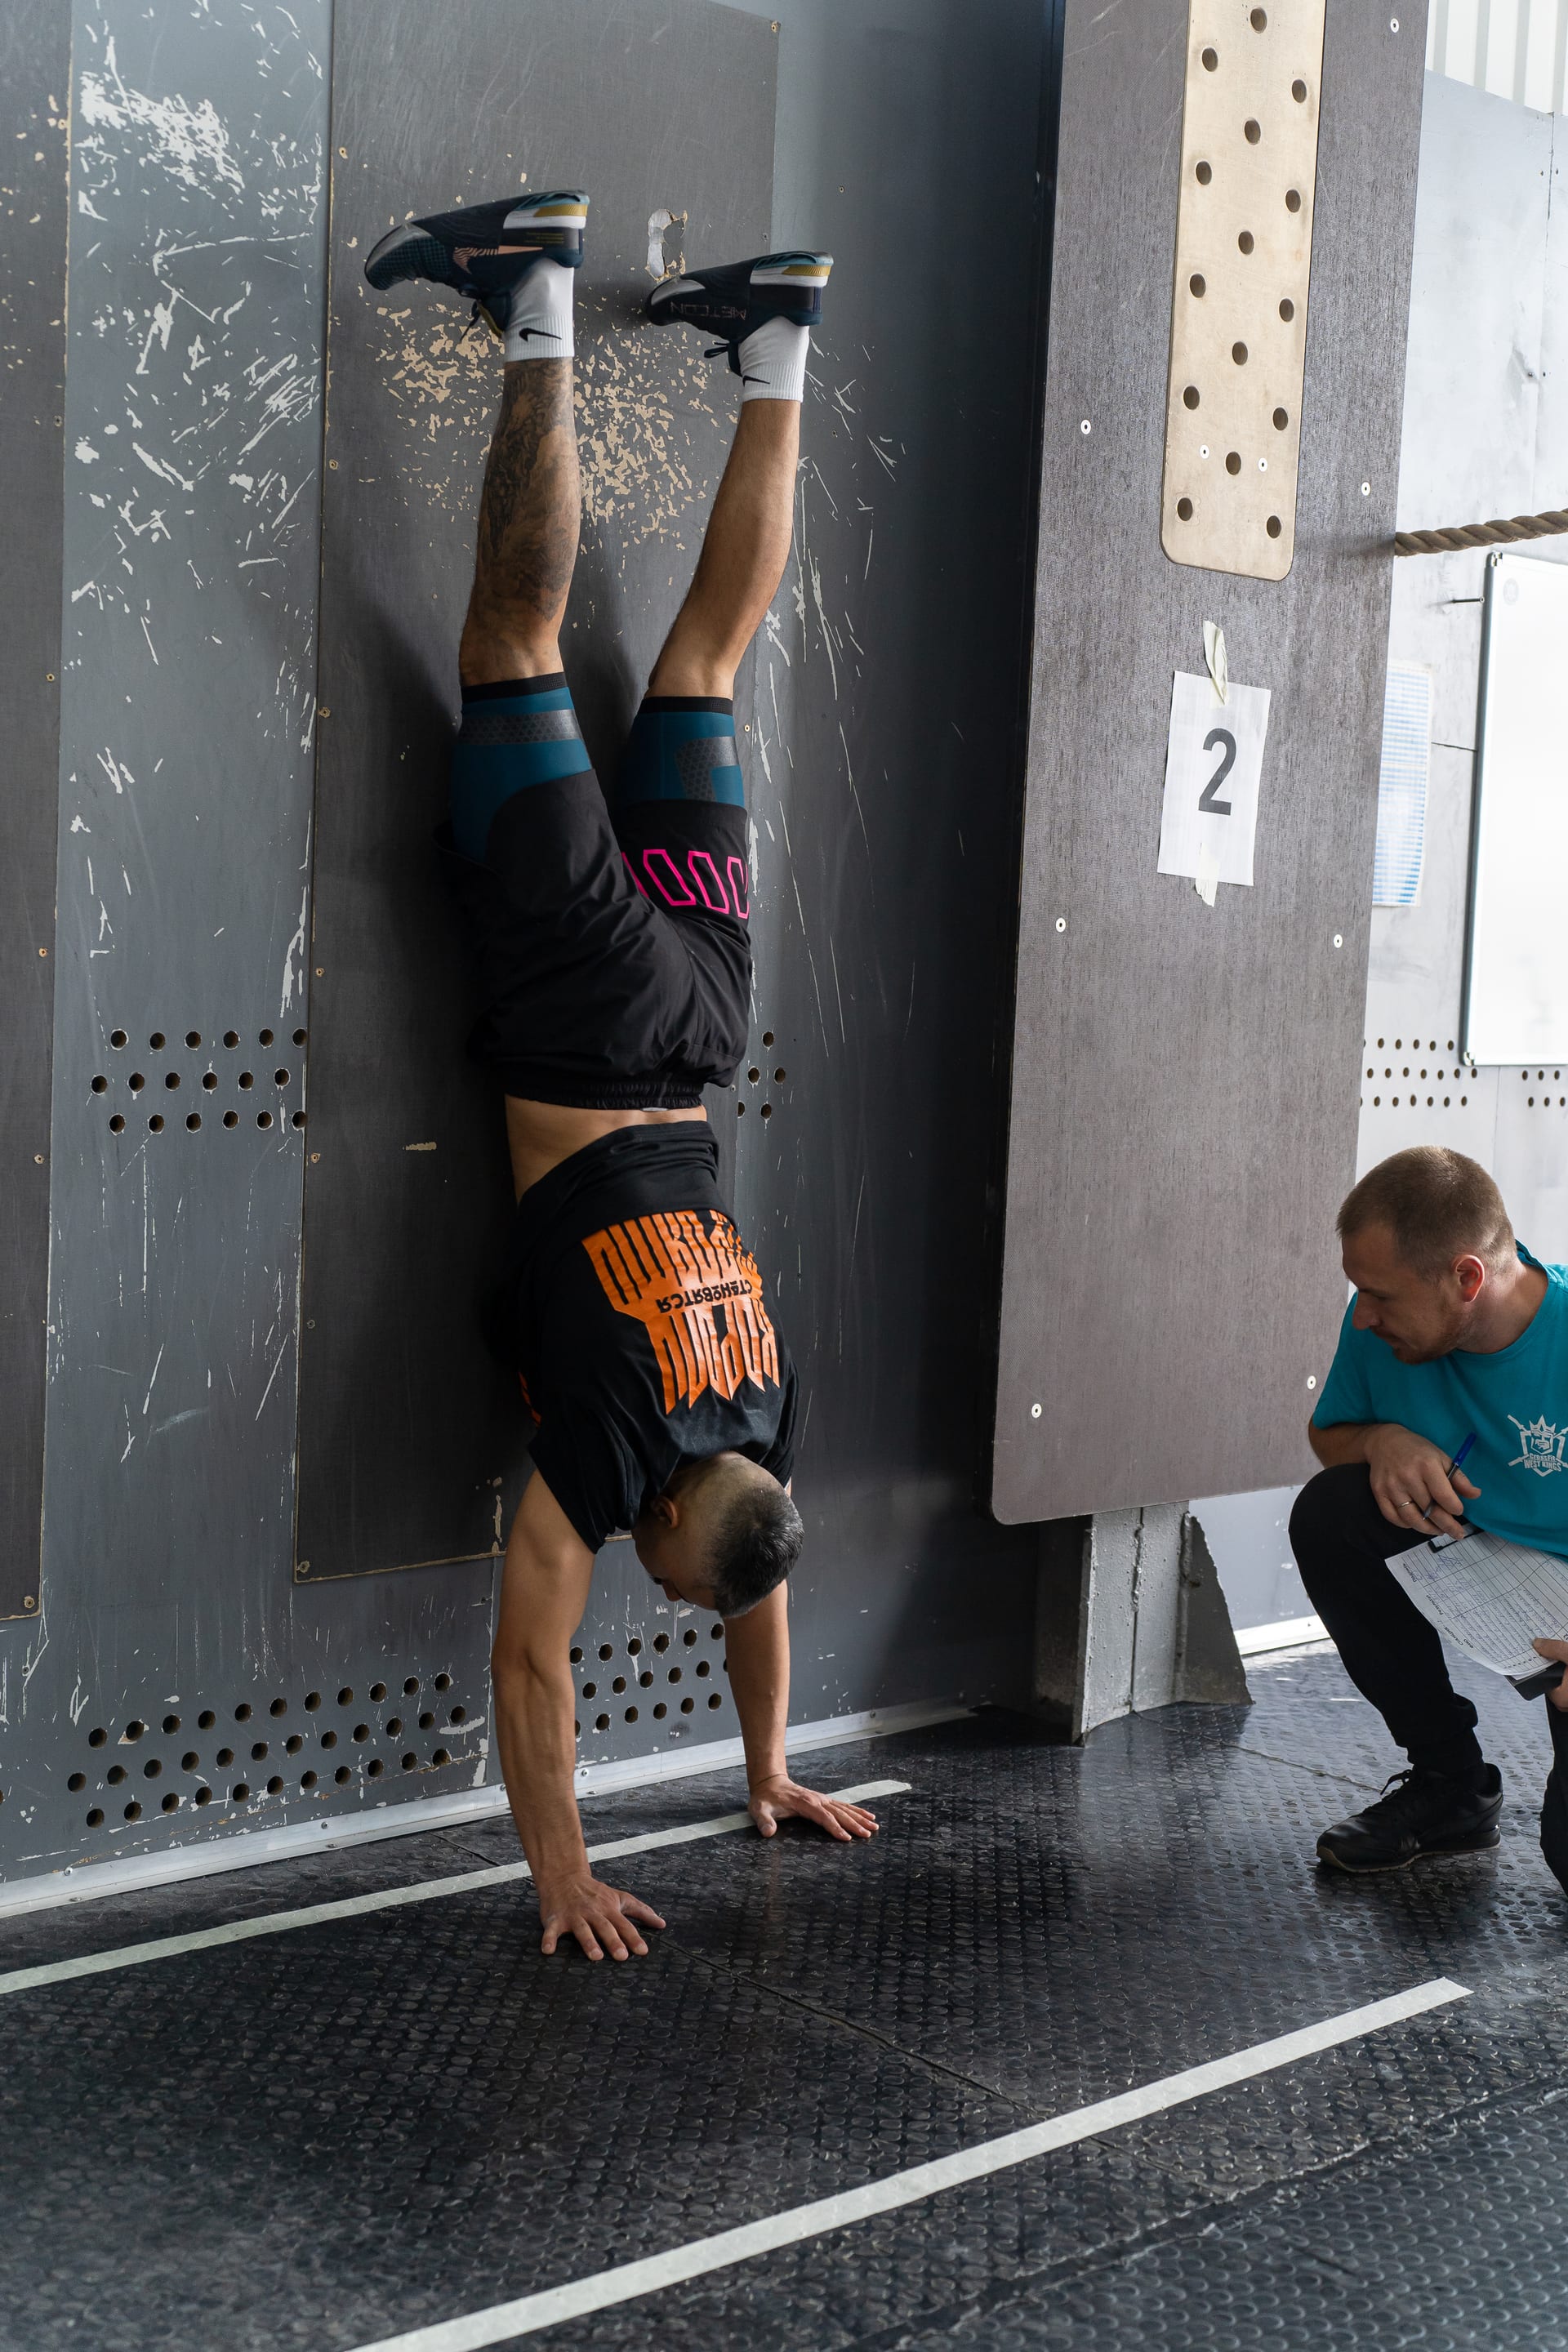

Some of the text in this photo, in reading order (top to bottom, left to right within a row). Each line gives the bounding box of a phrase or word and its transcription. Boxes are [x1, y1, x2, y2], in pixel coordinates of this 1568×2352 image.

[1197, 727, 1238, 816] 2
[656, 1280, 753, 1314] СТАНОВЯТСЯ
[1524, 1459, 1561, 1472] WEST KINGS
